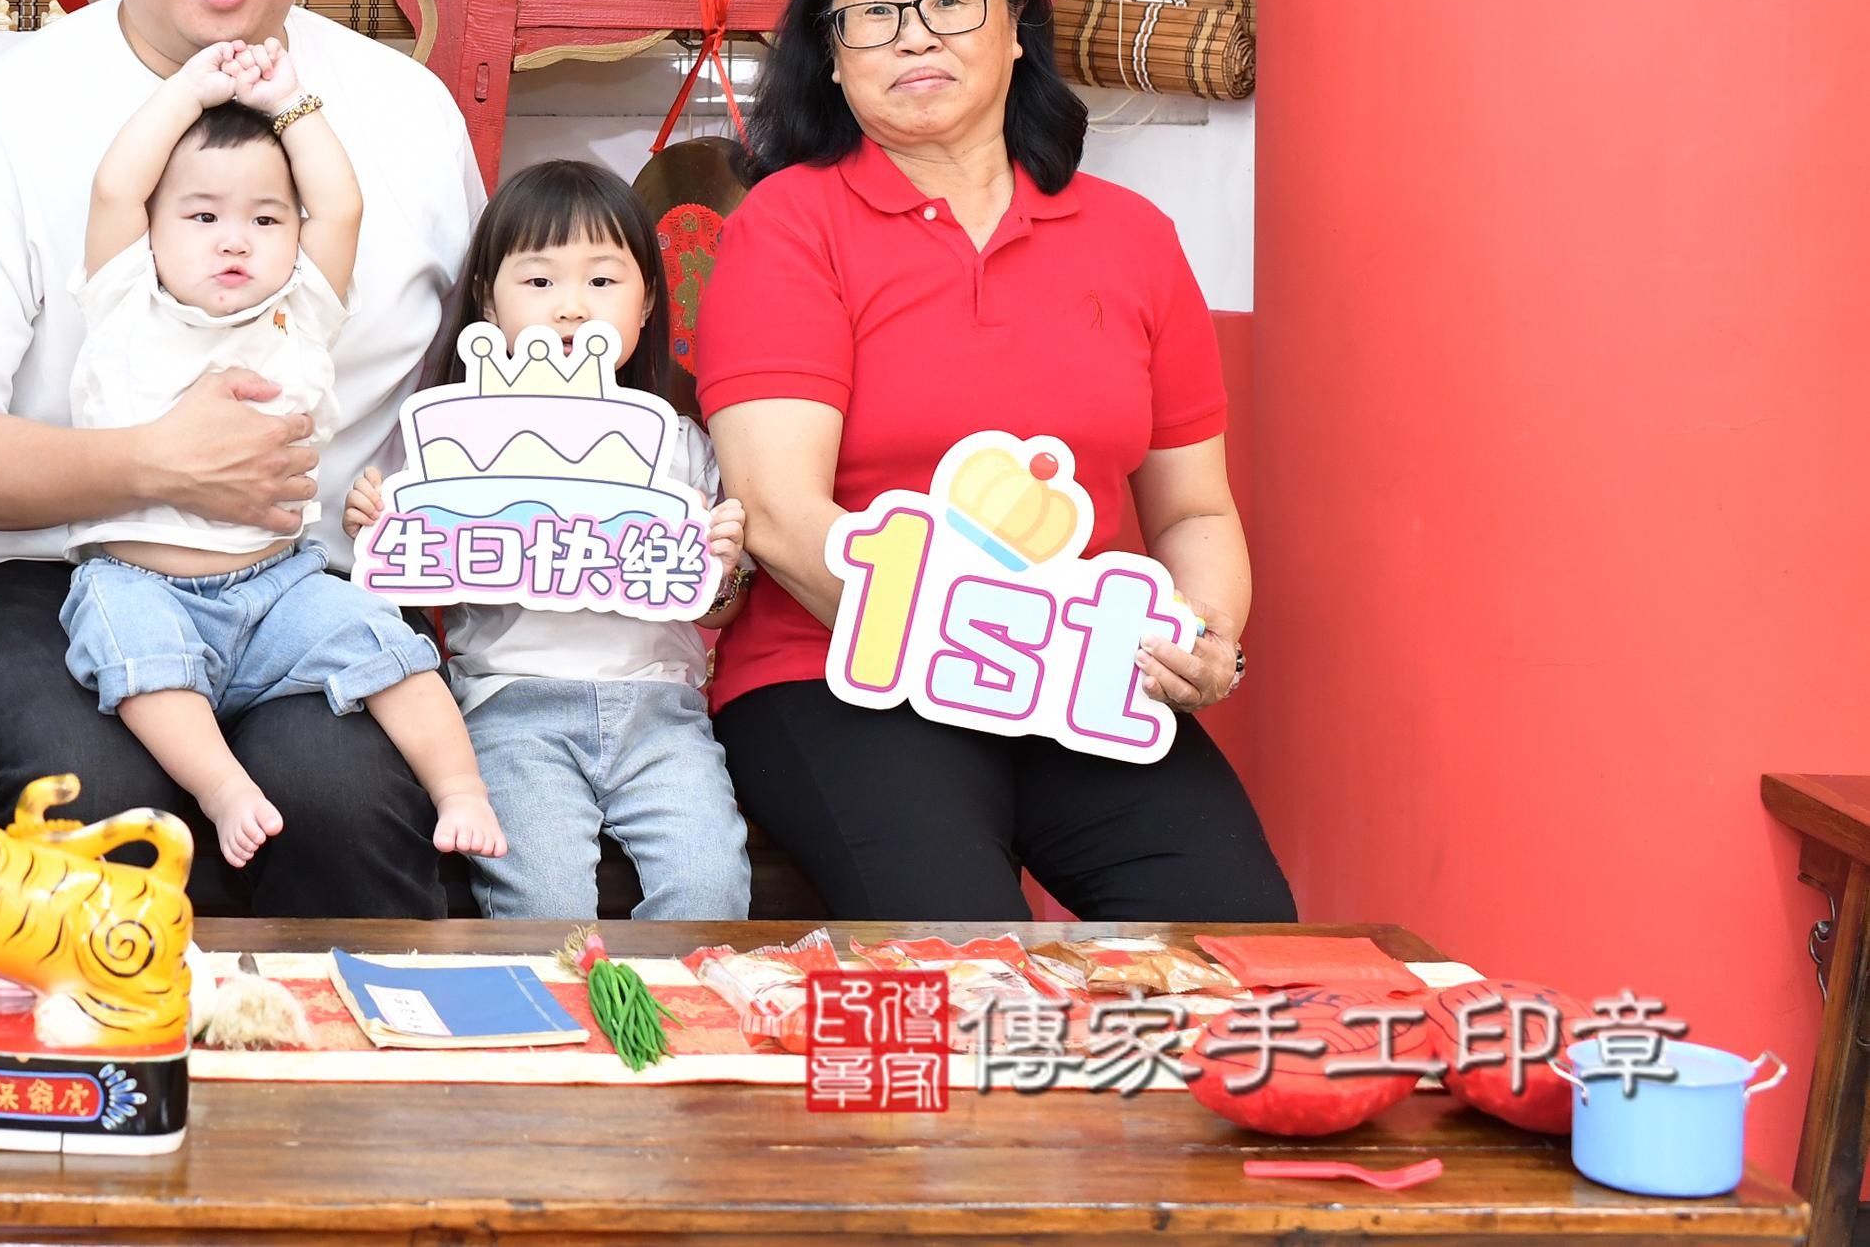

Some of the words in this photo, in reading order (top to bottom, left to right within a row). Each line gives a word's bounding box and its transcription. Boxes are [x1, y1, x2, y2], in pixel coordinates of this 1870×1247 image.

[368, 516, 706, 606] 生日快樂
[843, 506, 1182, 748] 1st
